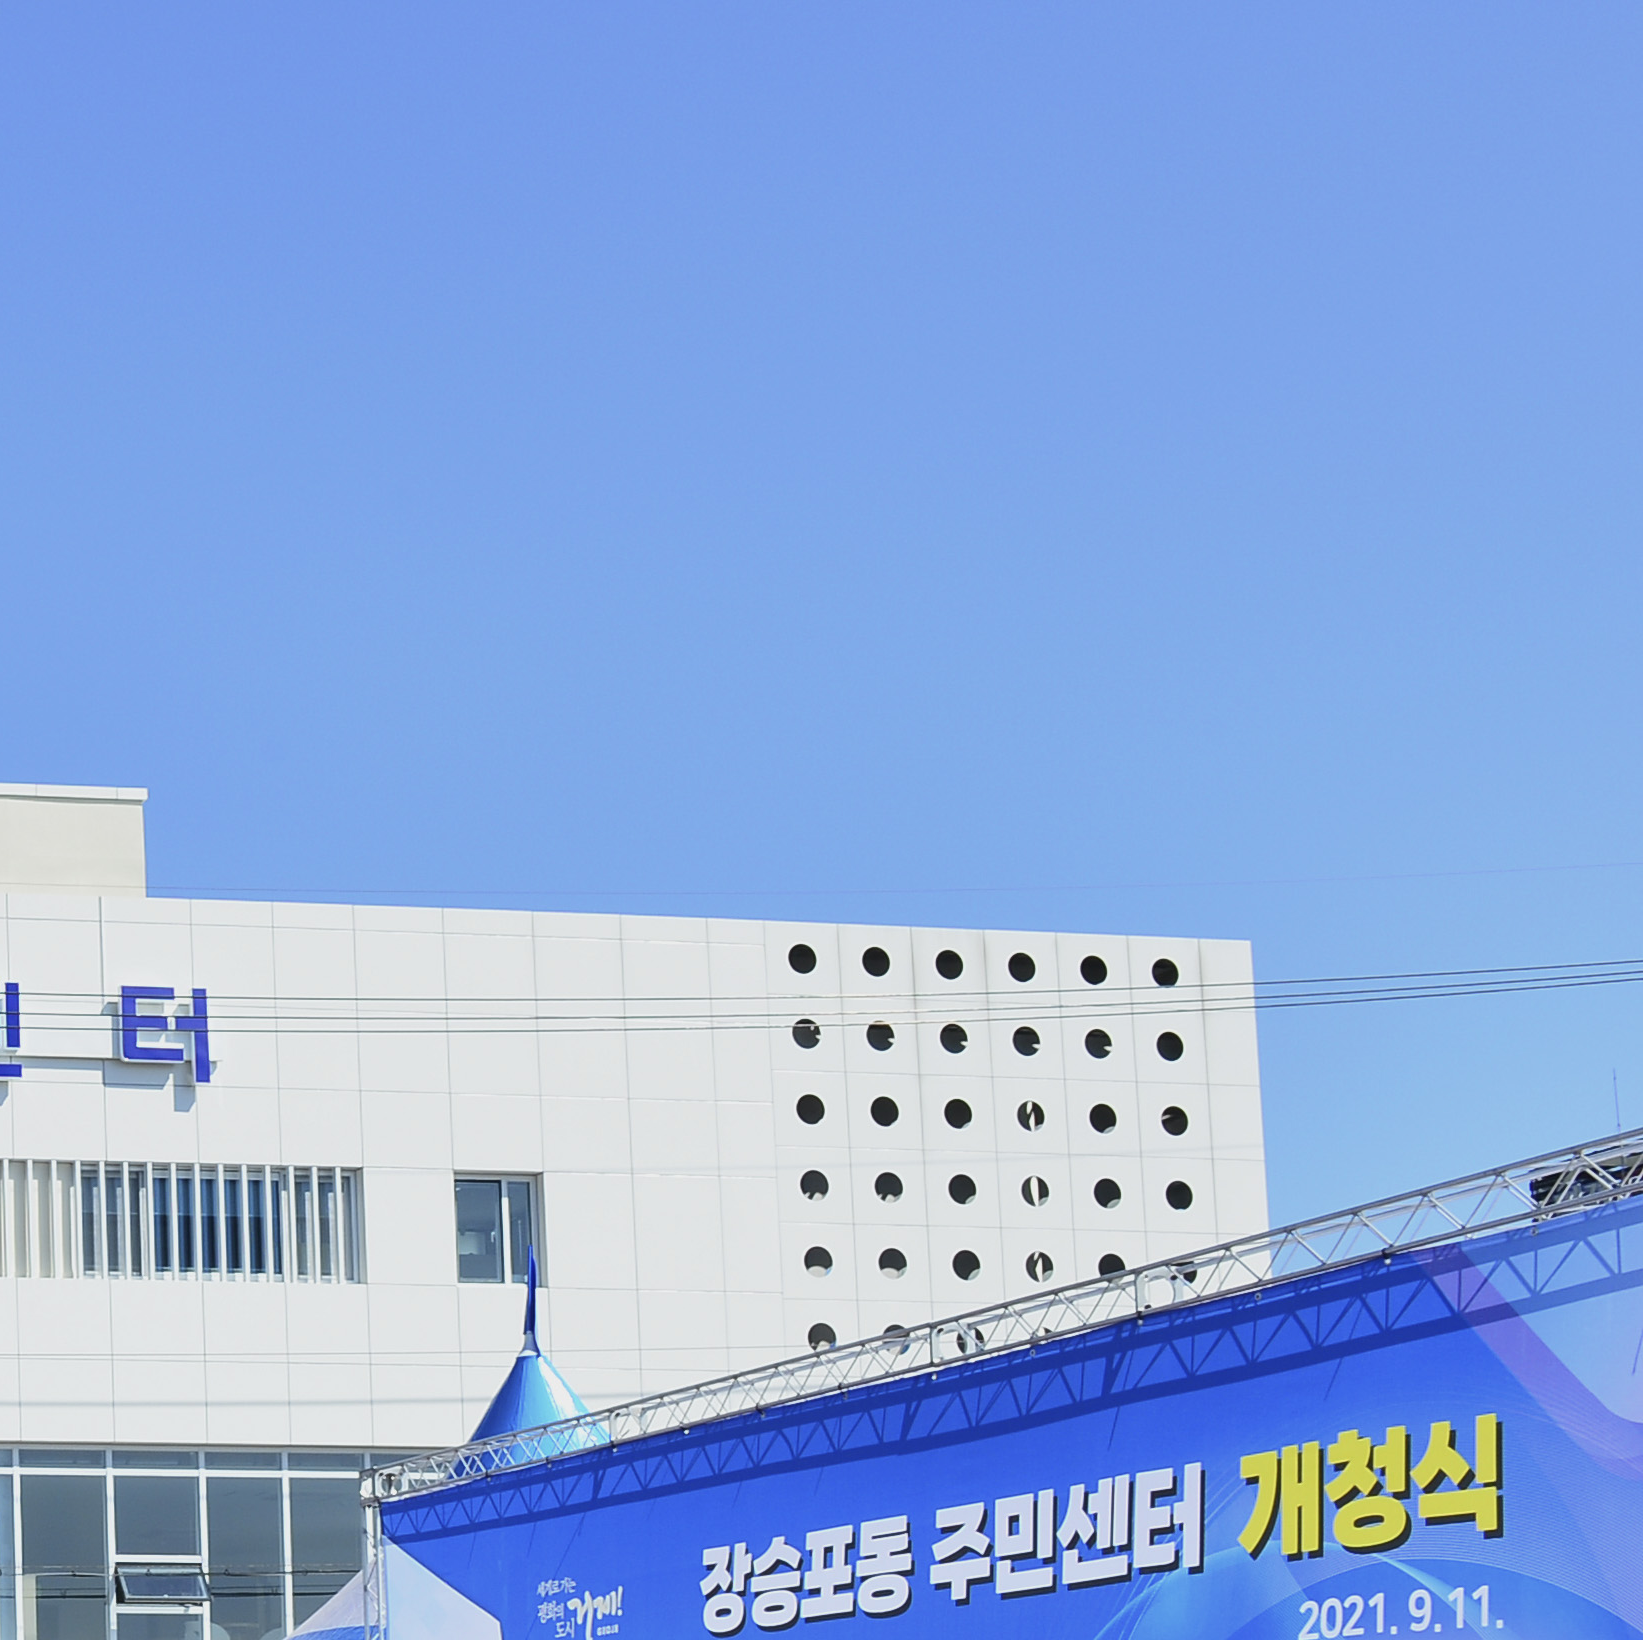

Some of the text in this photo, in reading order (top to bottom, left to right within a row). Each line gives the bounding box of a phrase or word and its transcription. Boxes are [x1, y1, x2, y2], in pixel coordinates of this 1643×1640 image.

[699, 1412, 1504, 1639] 장승포동 주민센터 개청식
[554, 1617, 575, 1639] 도시
